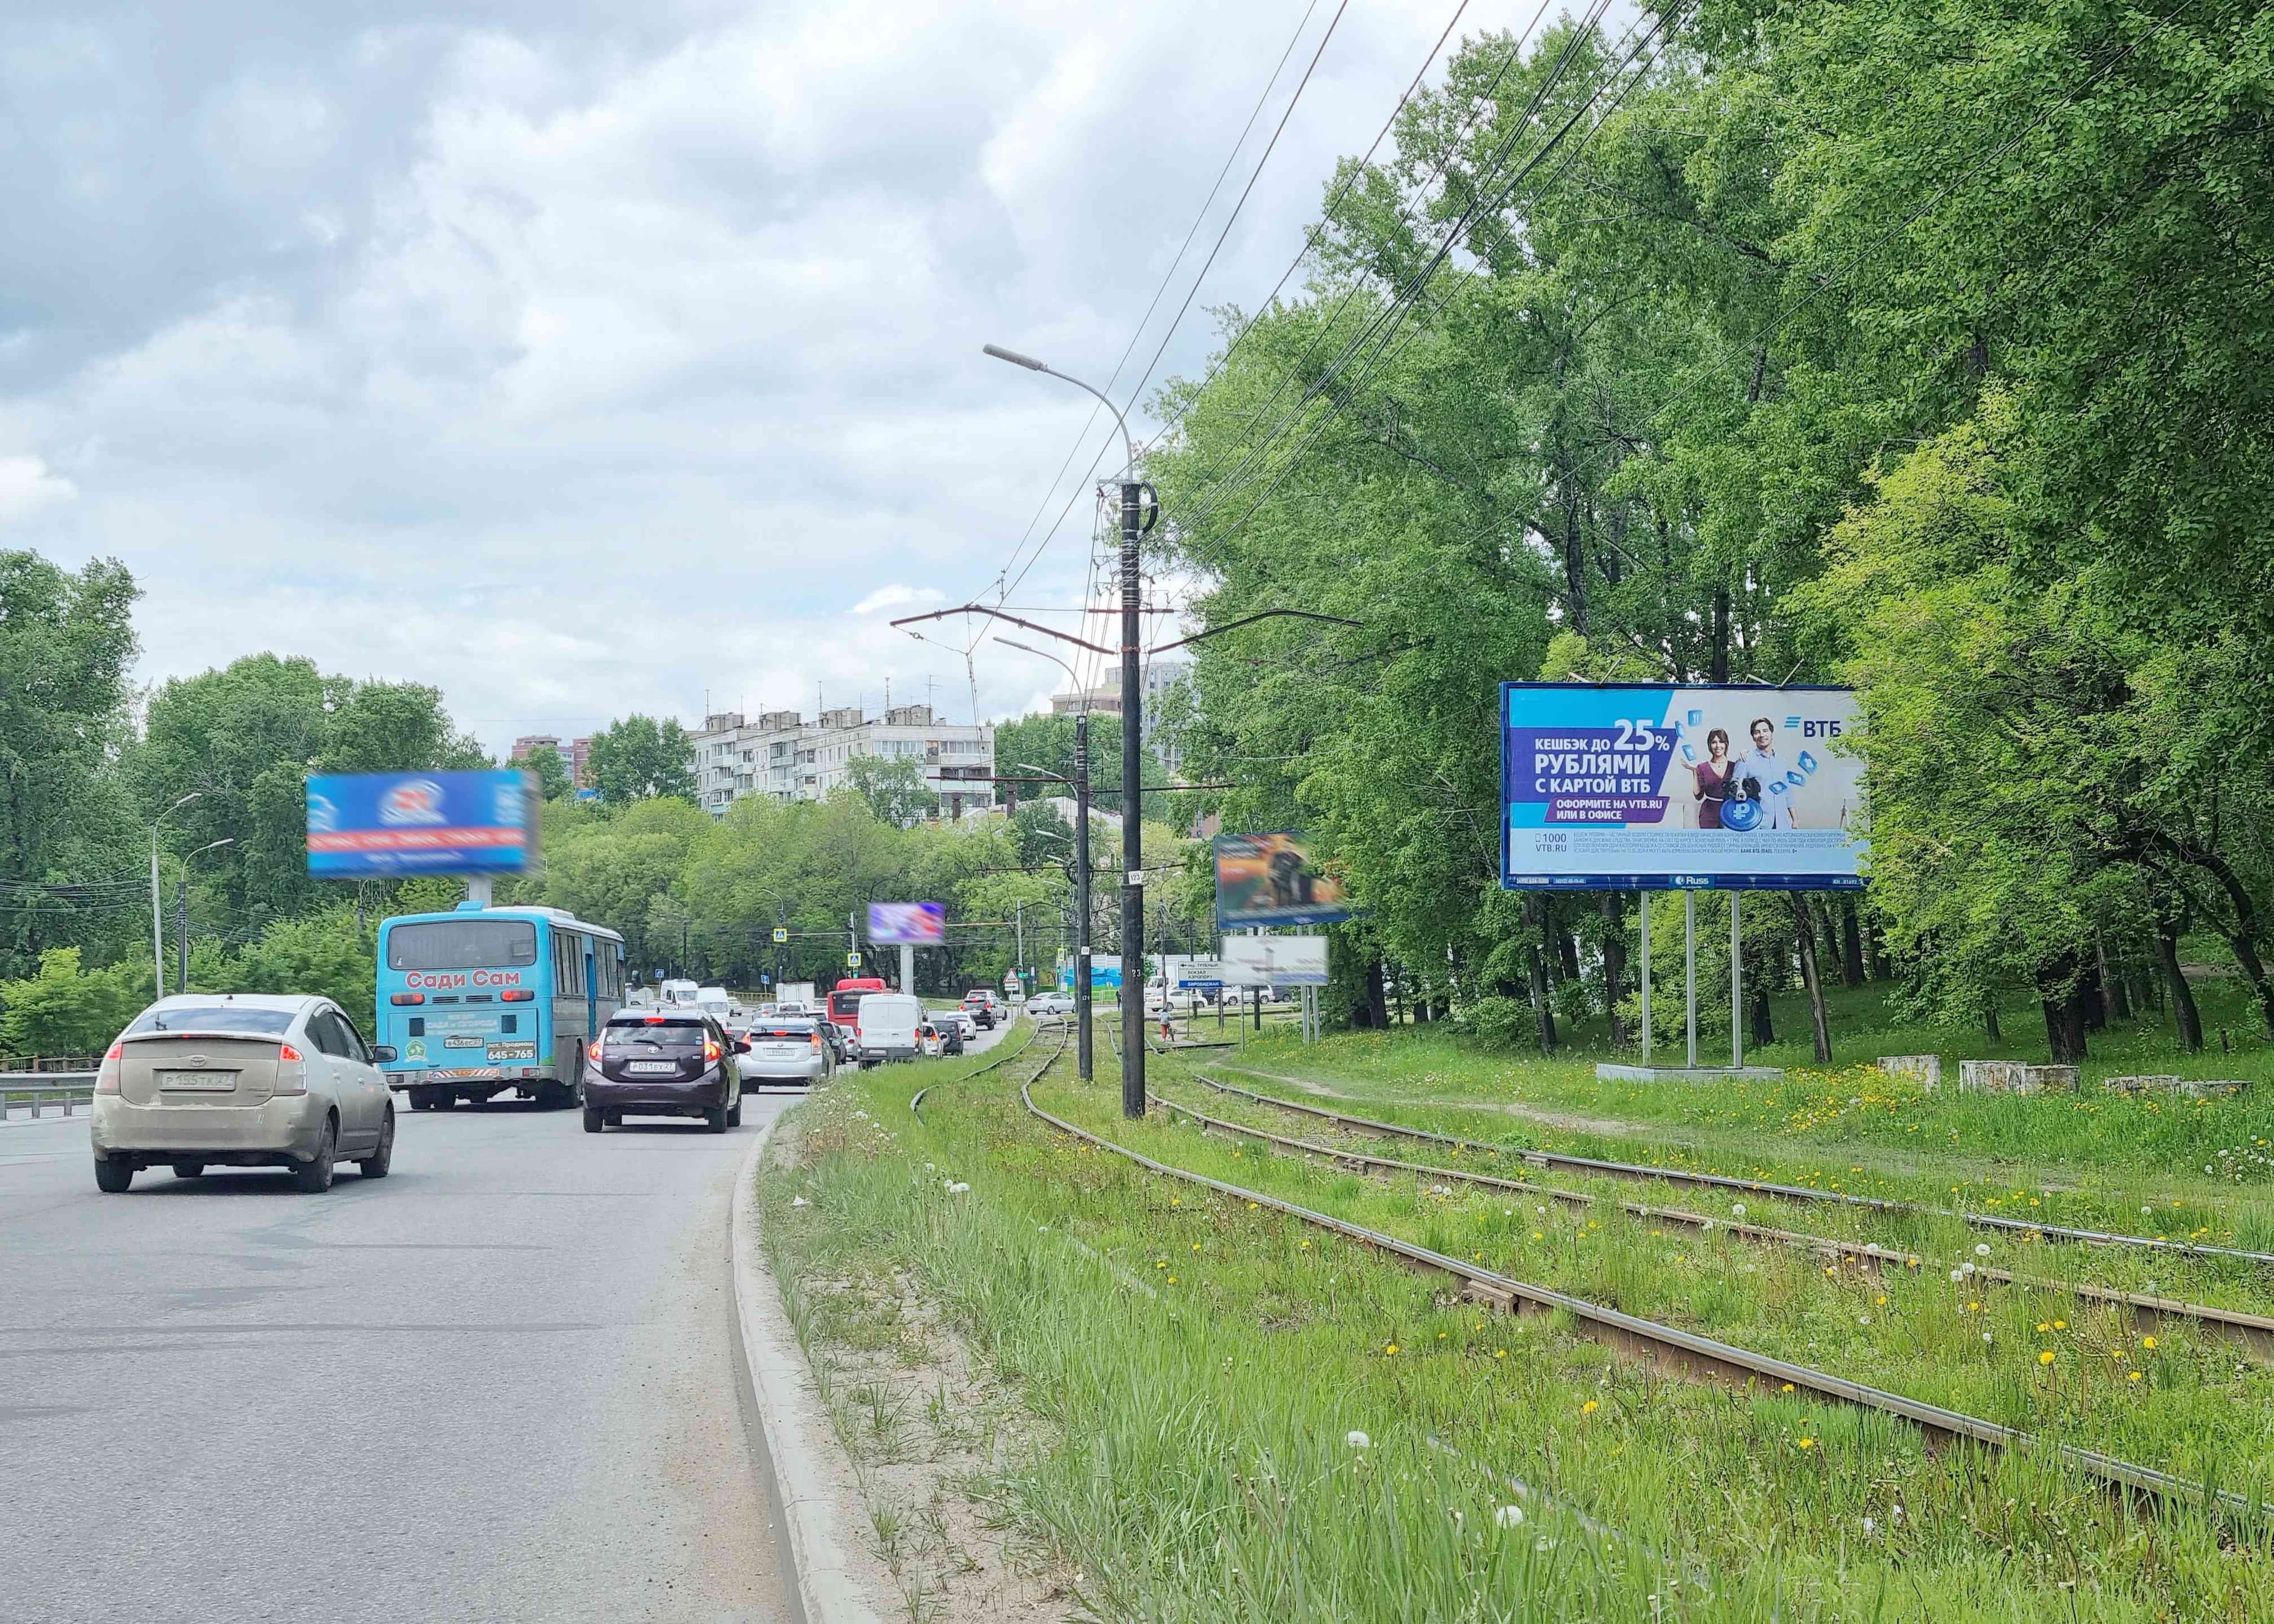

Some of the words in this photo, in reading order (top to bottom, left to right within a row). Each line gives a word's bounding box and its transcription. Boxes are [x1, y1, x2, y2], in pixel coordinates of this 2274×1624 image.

[1804, 721, 1842, 737] ВТБ
[1535, 738, 1588, 750] КЕШБЭК
[1591, 739, 1611, 752] ДО
[1614, 719, 1670, 751] 25%
[1535, 754, 1650, 774] РУБЛЯМИ
[1535, 778, 1546, 793] С
[1550, 776, 1616, 793] КАРТОЙ
[1621, 779, 1651, 793] ВТБ
[1556, 799, 1611, 809] ОФОРМИТЕ
[1613, 800, 1627, 809] НА
[1629, 800, 1662, 809] VTB.RU
[1556, 811, 1578, 819] ИЛИ
[1579, 811, 1586, 819] В
[1588, 810, 1622, 820] ОФИСЕ
[1543, 833, 1567, 842] 1000
[1536, 844, 1567, 853] VTB.RU
[1686, 876, 1709, 885] Russ
[406, 972, 466, 989] Сади
[473, 970, 520, 986] Сам
[488, 1049, 534, 1060] 645-765
